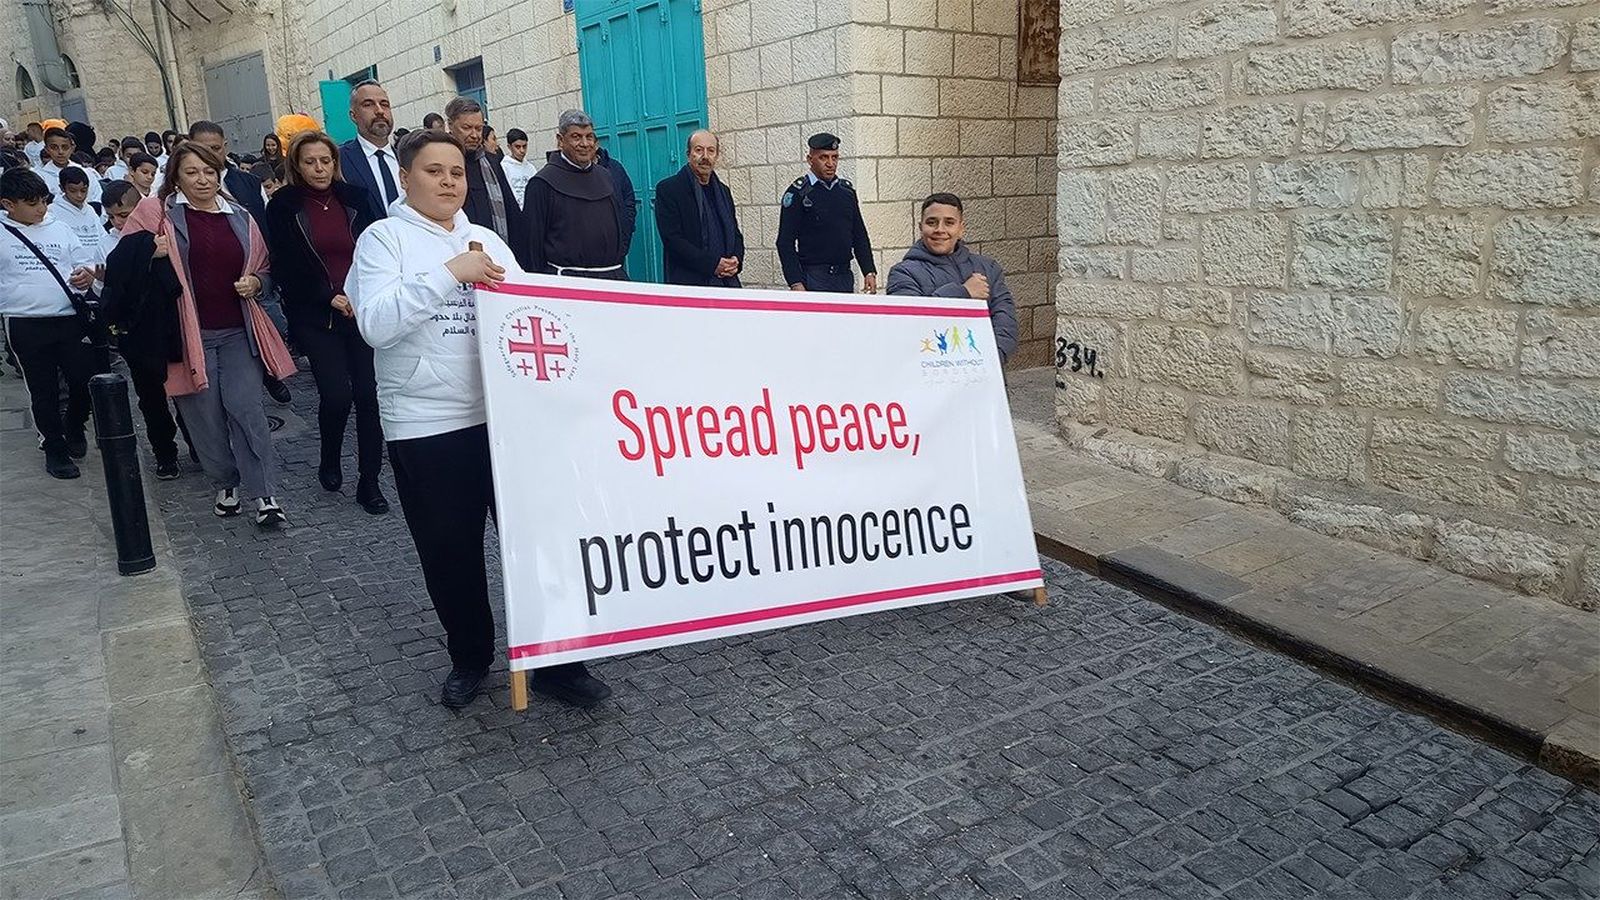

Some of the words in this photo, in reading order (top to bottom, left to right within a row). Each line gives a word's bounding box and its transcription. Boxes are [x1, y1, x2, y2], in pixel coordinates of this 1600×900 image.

[921, 359, 955, 368] CHILDREN
[955, 358, 984, 367] WITHOUT
[612, 388, 778, 477] Spread
[788, 399, 921, 470] peace,
[579, 510, 760, 616] protect
[767, 501, 973, 573] innocence
